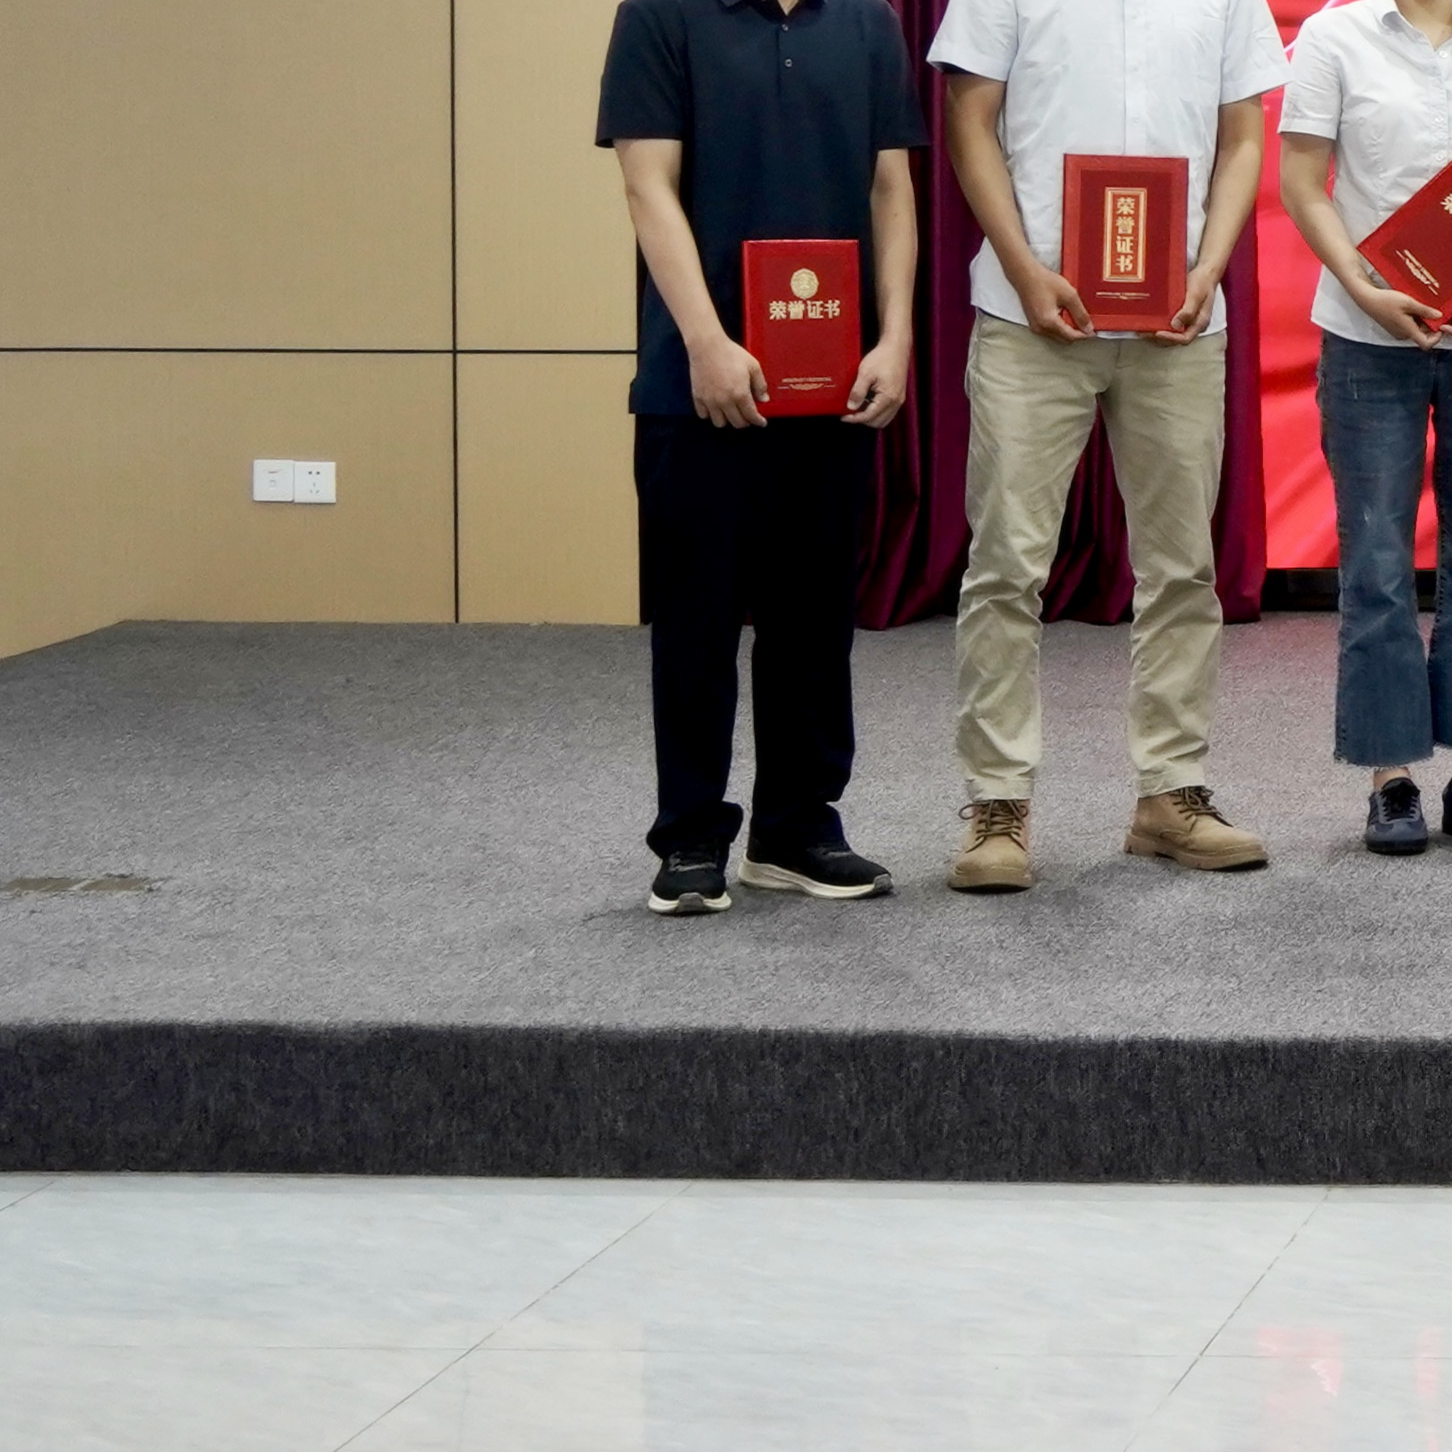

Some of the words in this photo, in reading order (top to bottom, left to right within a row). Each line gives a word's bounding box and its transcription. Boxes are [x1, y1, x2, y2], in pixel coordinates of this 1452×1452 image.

[1116, 197, 1136, 273] 荣誉证书
[769, 300, 840, 320] 荣誉证书
